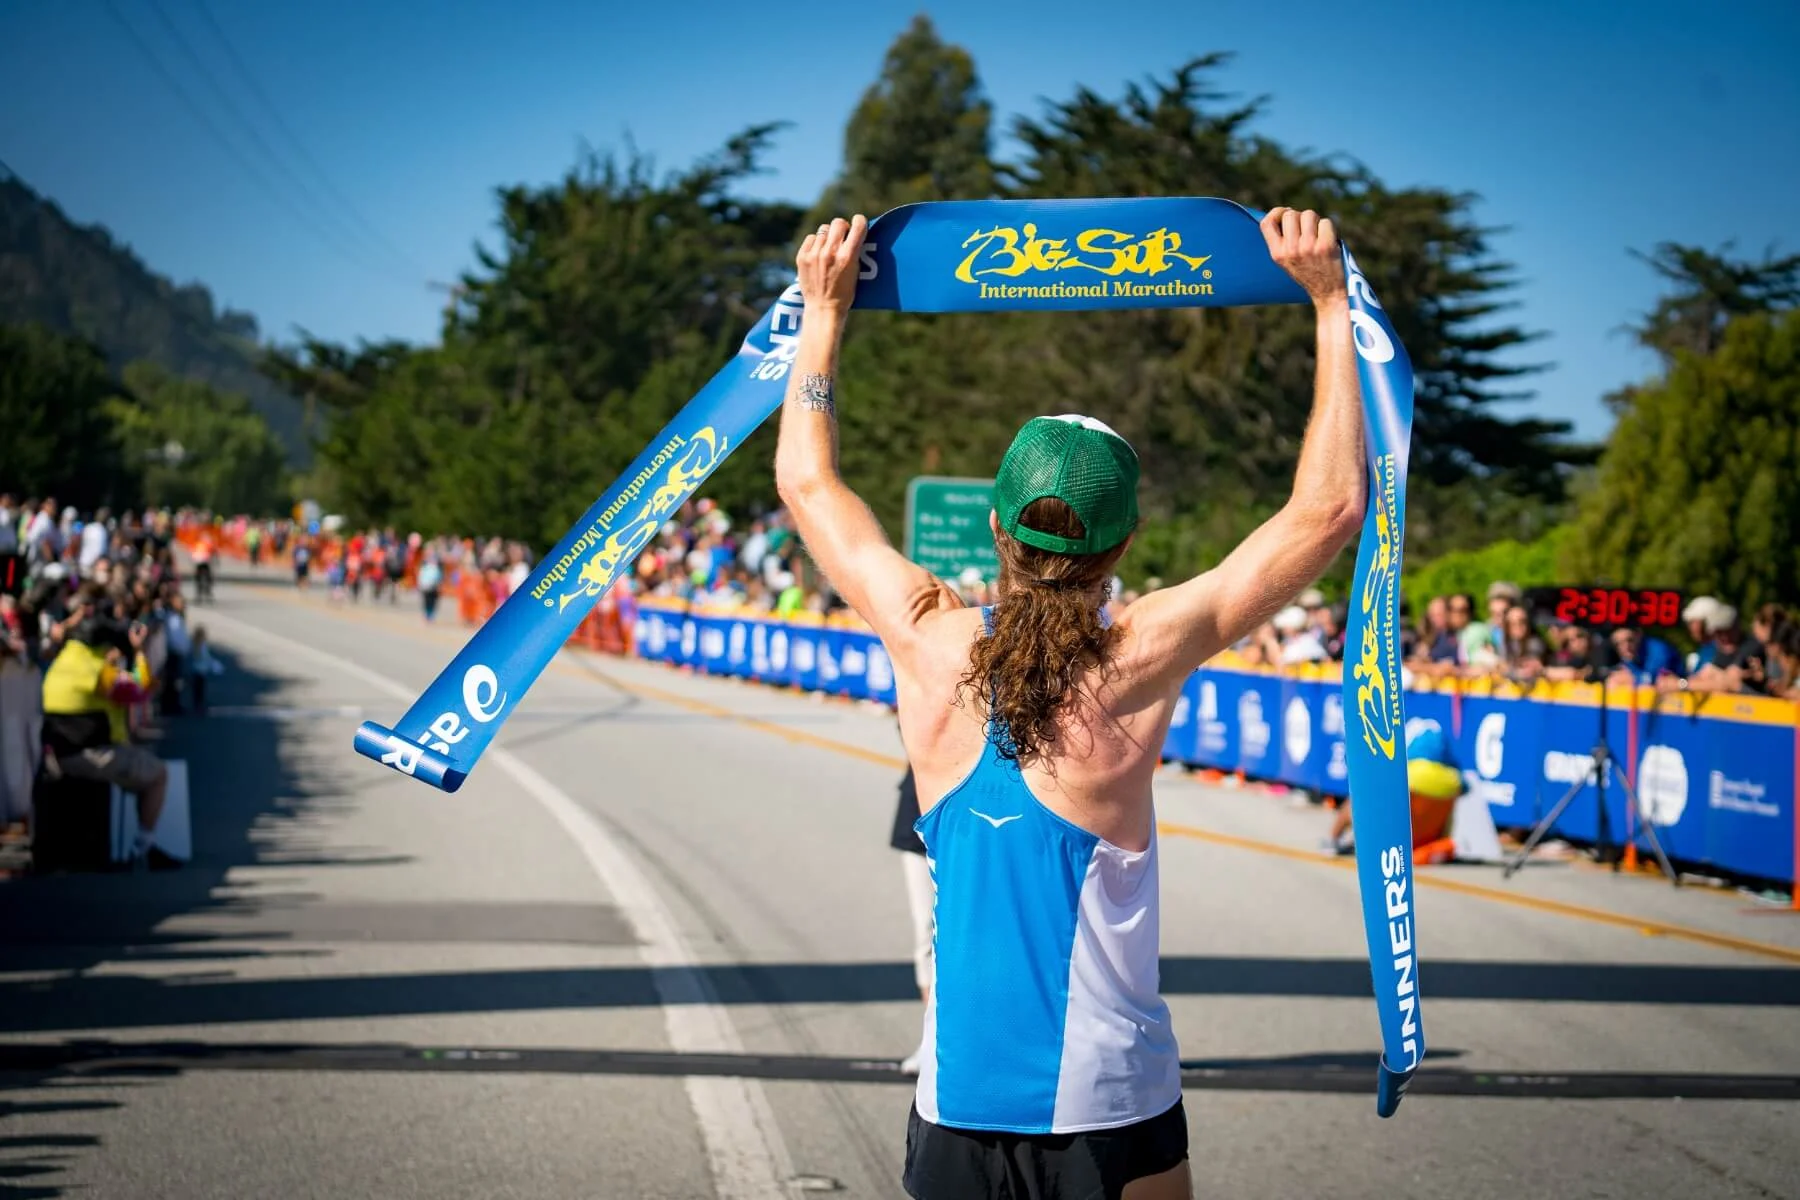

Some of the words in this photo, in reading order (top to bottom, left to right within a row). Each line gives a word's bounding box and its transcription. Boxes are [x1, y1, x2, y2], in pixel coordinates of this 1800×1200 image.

[979, 281, 1108, 299] International
[1113, 279, 1215, 297] Marathon
[598, 434, 687, 531] International
[1384, 453, 1400, 565] Marathon
[530, 526, 603, 600] Marathon
[1383, 569, 1401, 727] International
